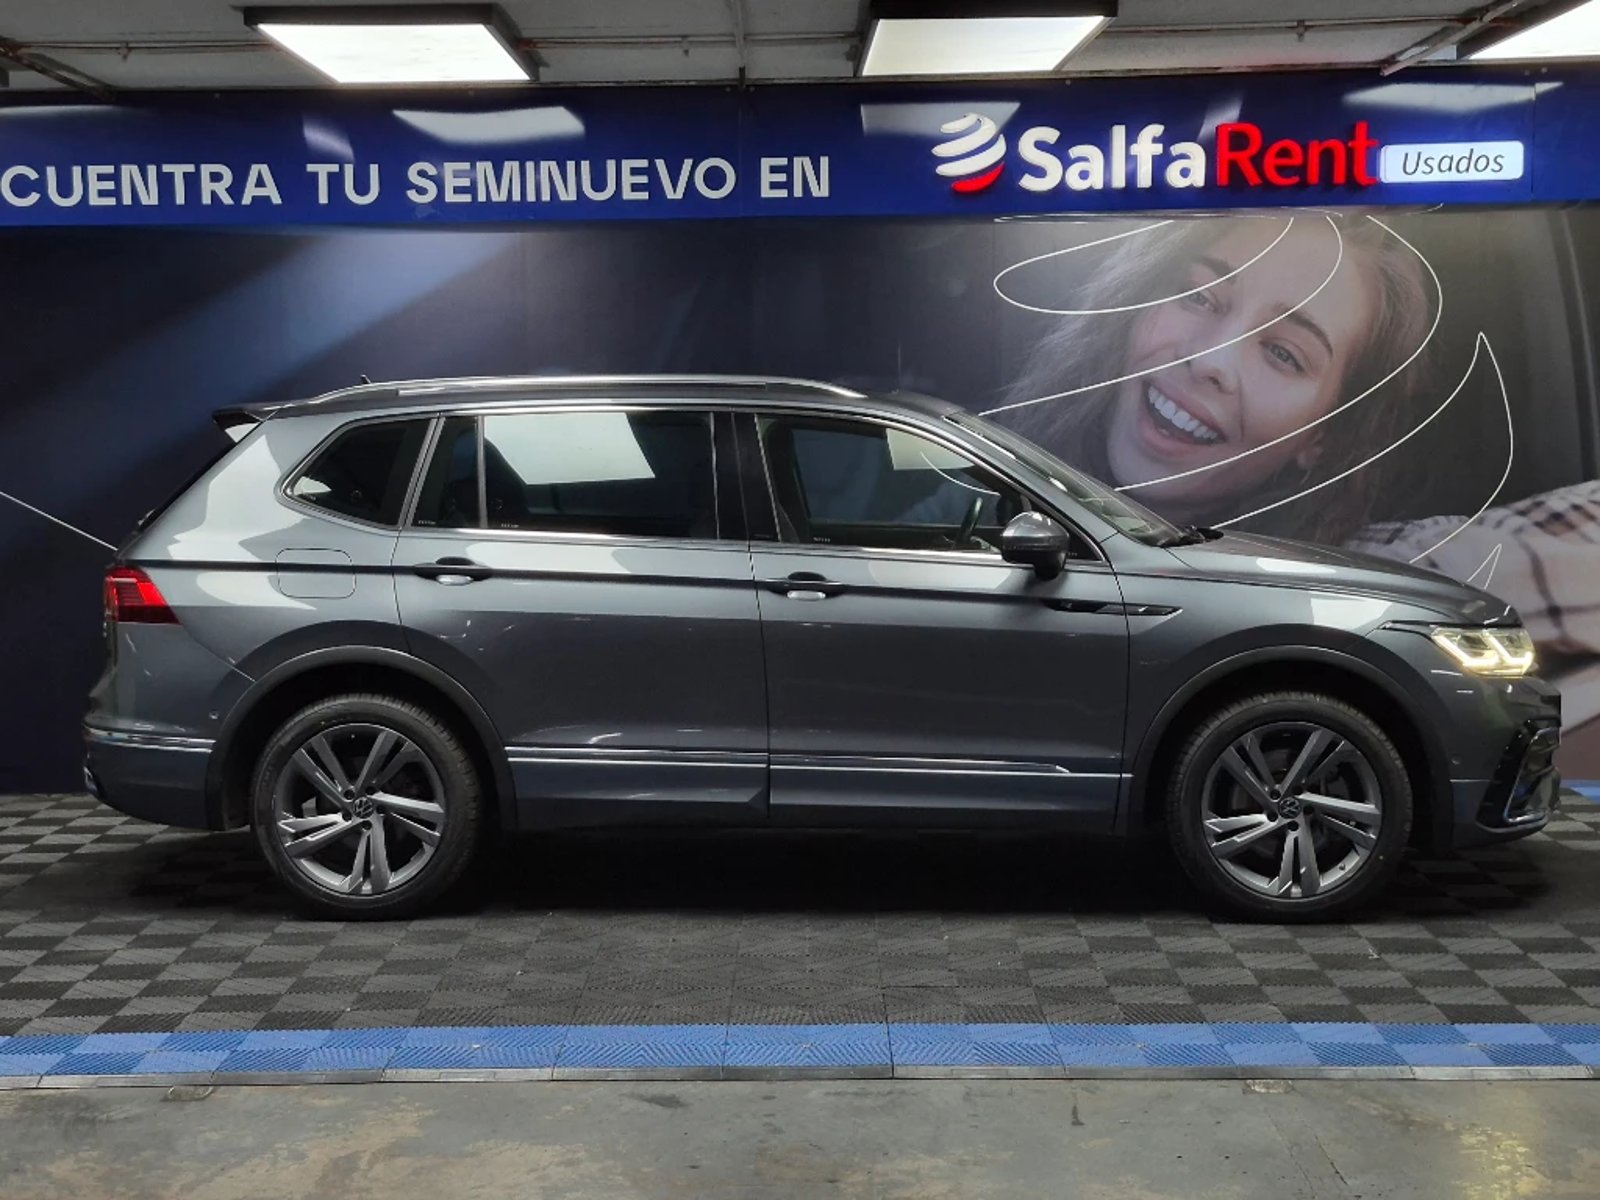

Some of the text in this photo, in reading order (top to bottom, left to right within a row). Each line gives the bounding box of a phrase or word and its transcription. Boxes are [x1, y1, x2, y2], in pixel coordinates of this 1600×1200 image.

[0, 156, 829, 207] CUENTRA TU SEMINUEVO EN
[1401, 148, 1506, 178] Usados
